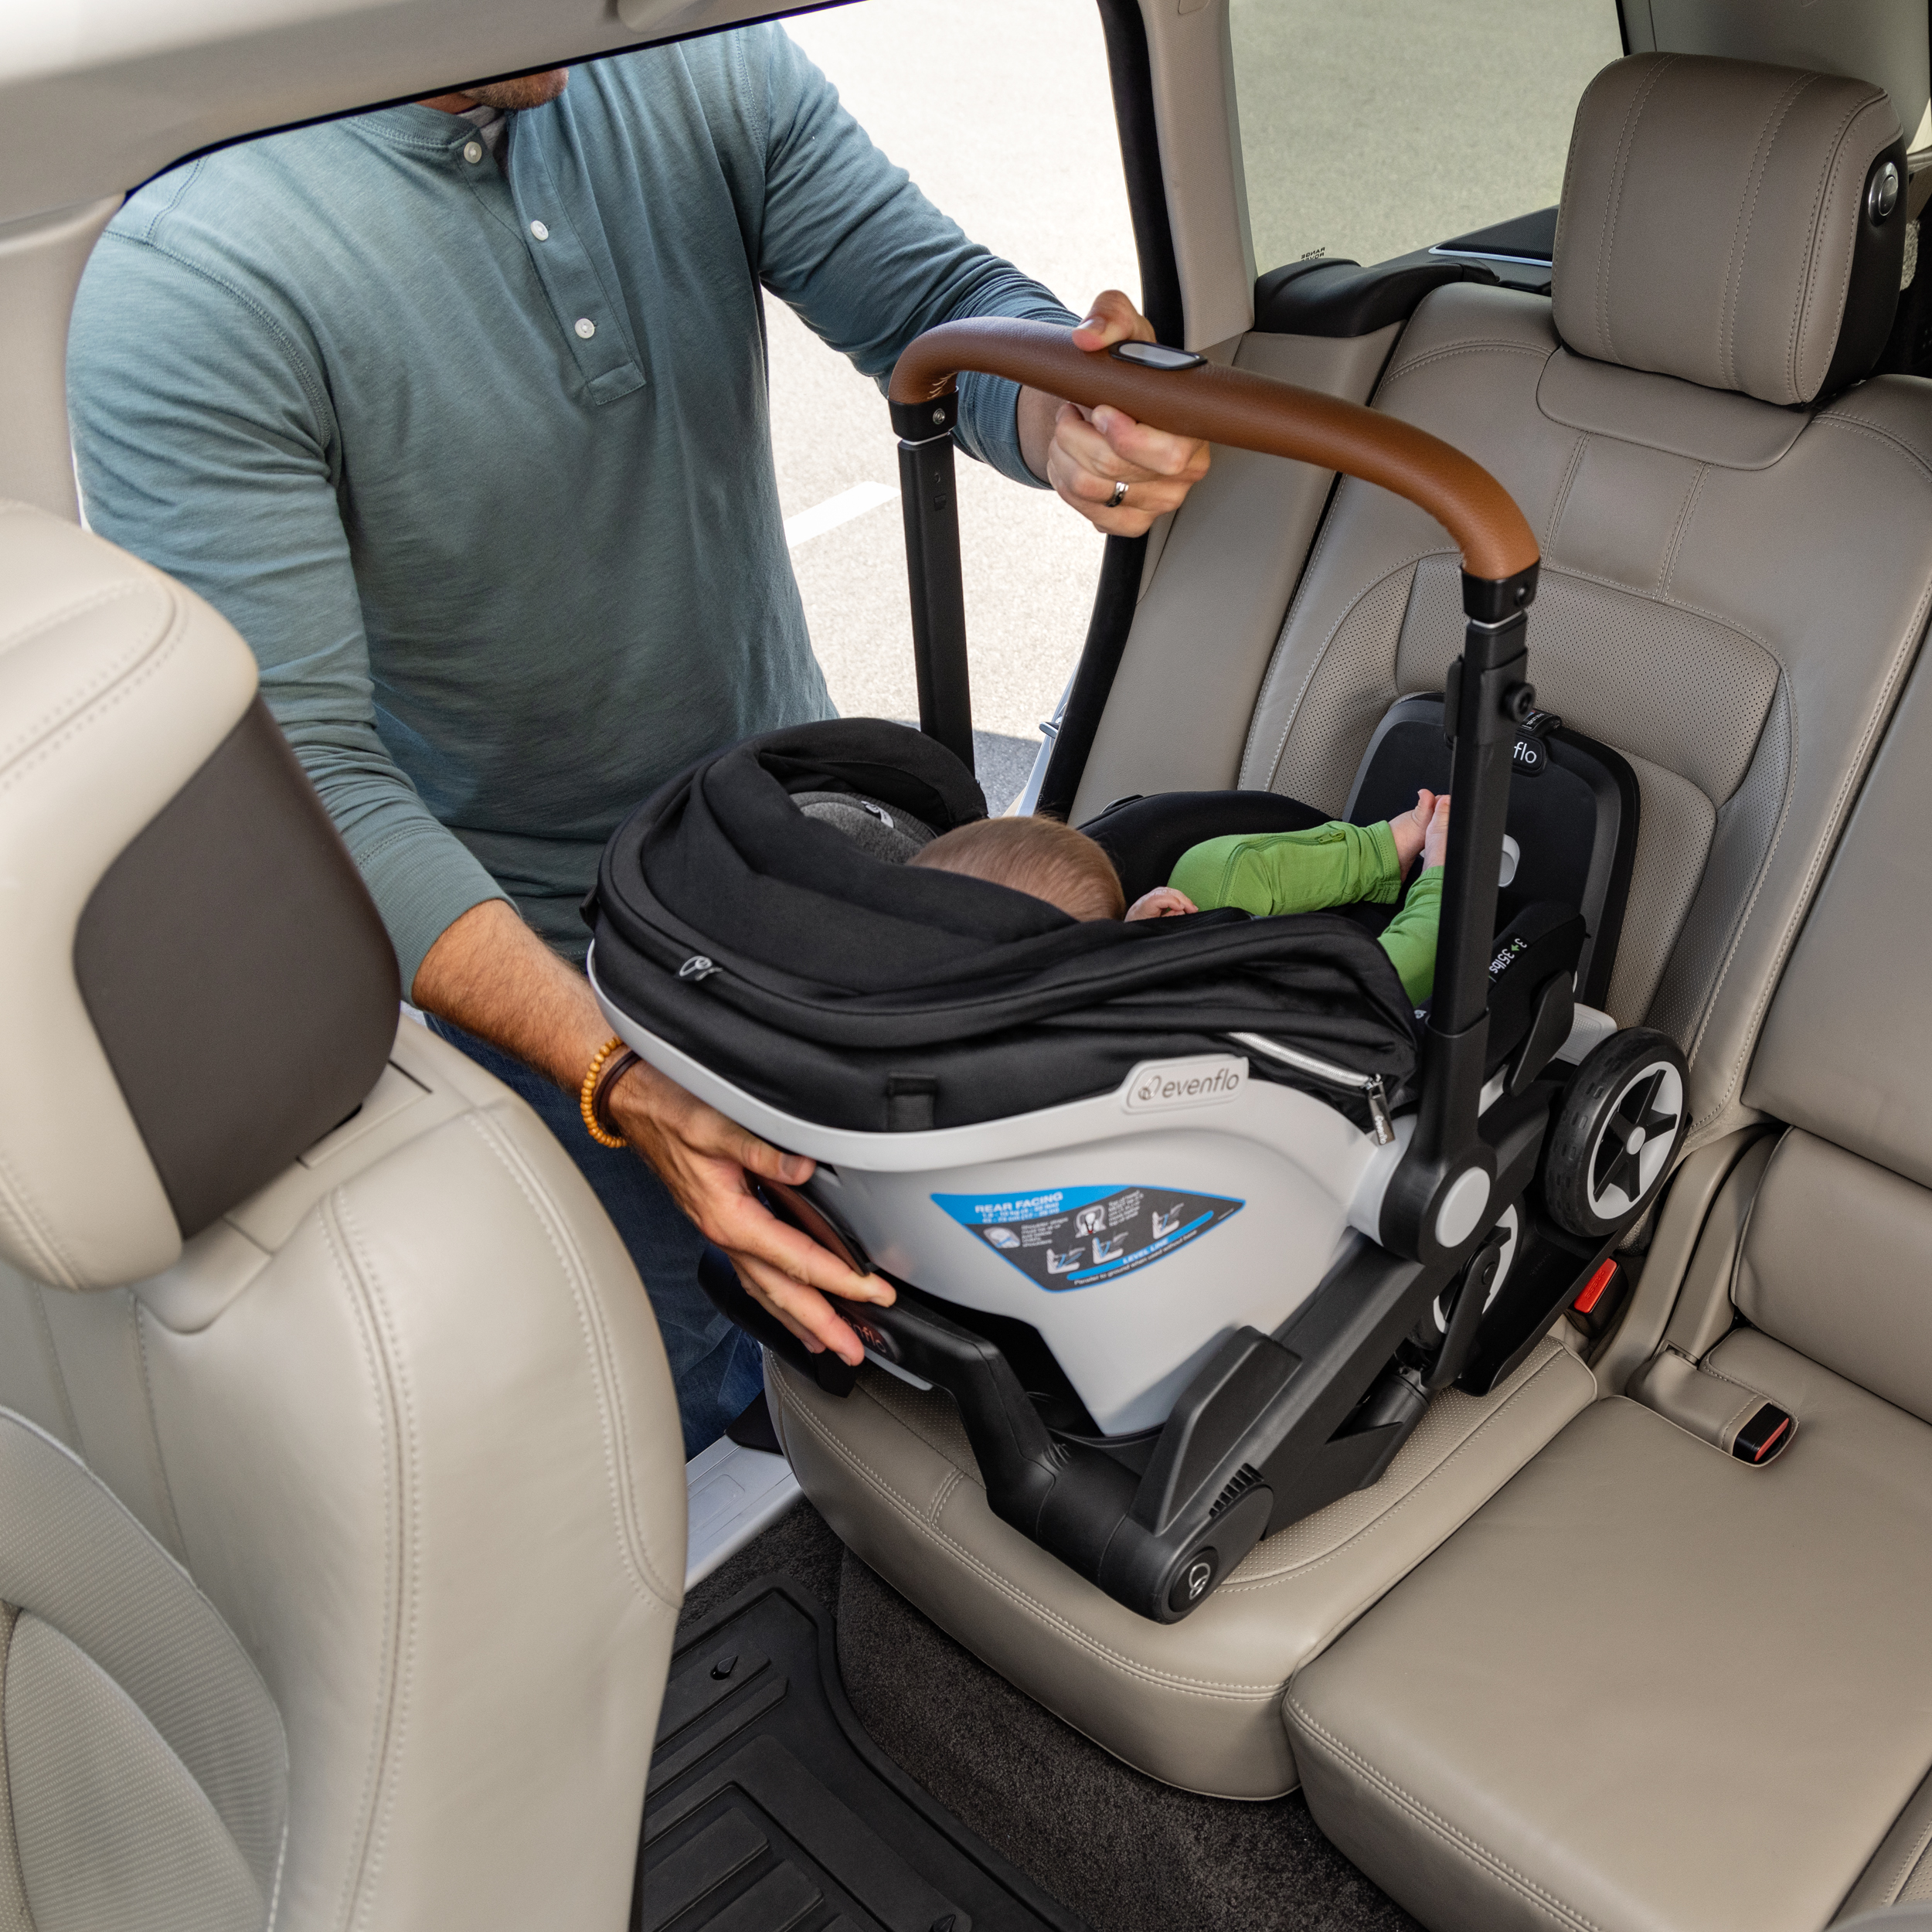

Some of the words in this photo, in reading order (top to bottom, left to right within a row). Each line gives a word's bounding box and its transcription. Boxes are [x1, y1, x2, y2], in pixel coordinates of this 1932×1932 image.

[1513, 741, 1537, 764] flo
[1514, 937, 1528, 948] 3
[1488, 948, 1515, 974] 35lbs
[1162, 1067, 1240, 1098] evenflo
[975, 1202, 1012, 1213] REAR
[1015, 1191, 1063, 1210] FACING
[1073, 1275, 1099, 1286] Parallel
[1107, 1264, 1130, 1277] ground
[1131, 1257, 1148, 1268] when
[1148, 1248, 1163, 1260] used
[1163, 1237, 1183, 1252] without
[1122, 1247, 1149, 1265] LEVEL
[1150, 1237, 1168, 1253] LINE
[1584, 1268, 1605, 1299] PRESS
